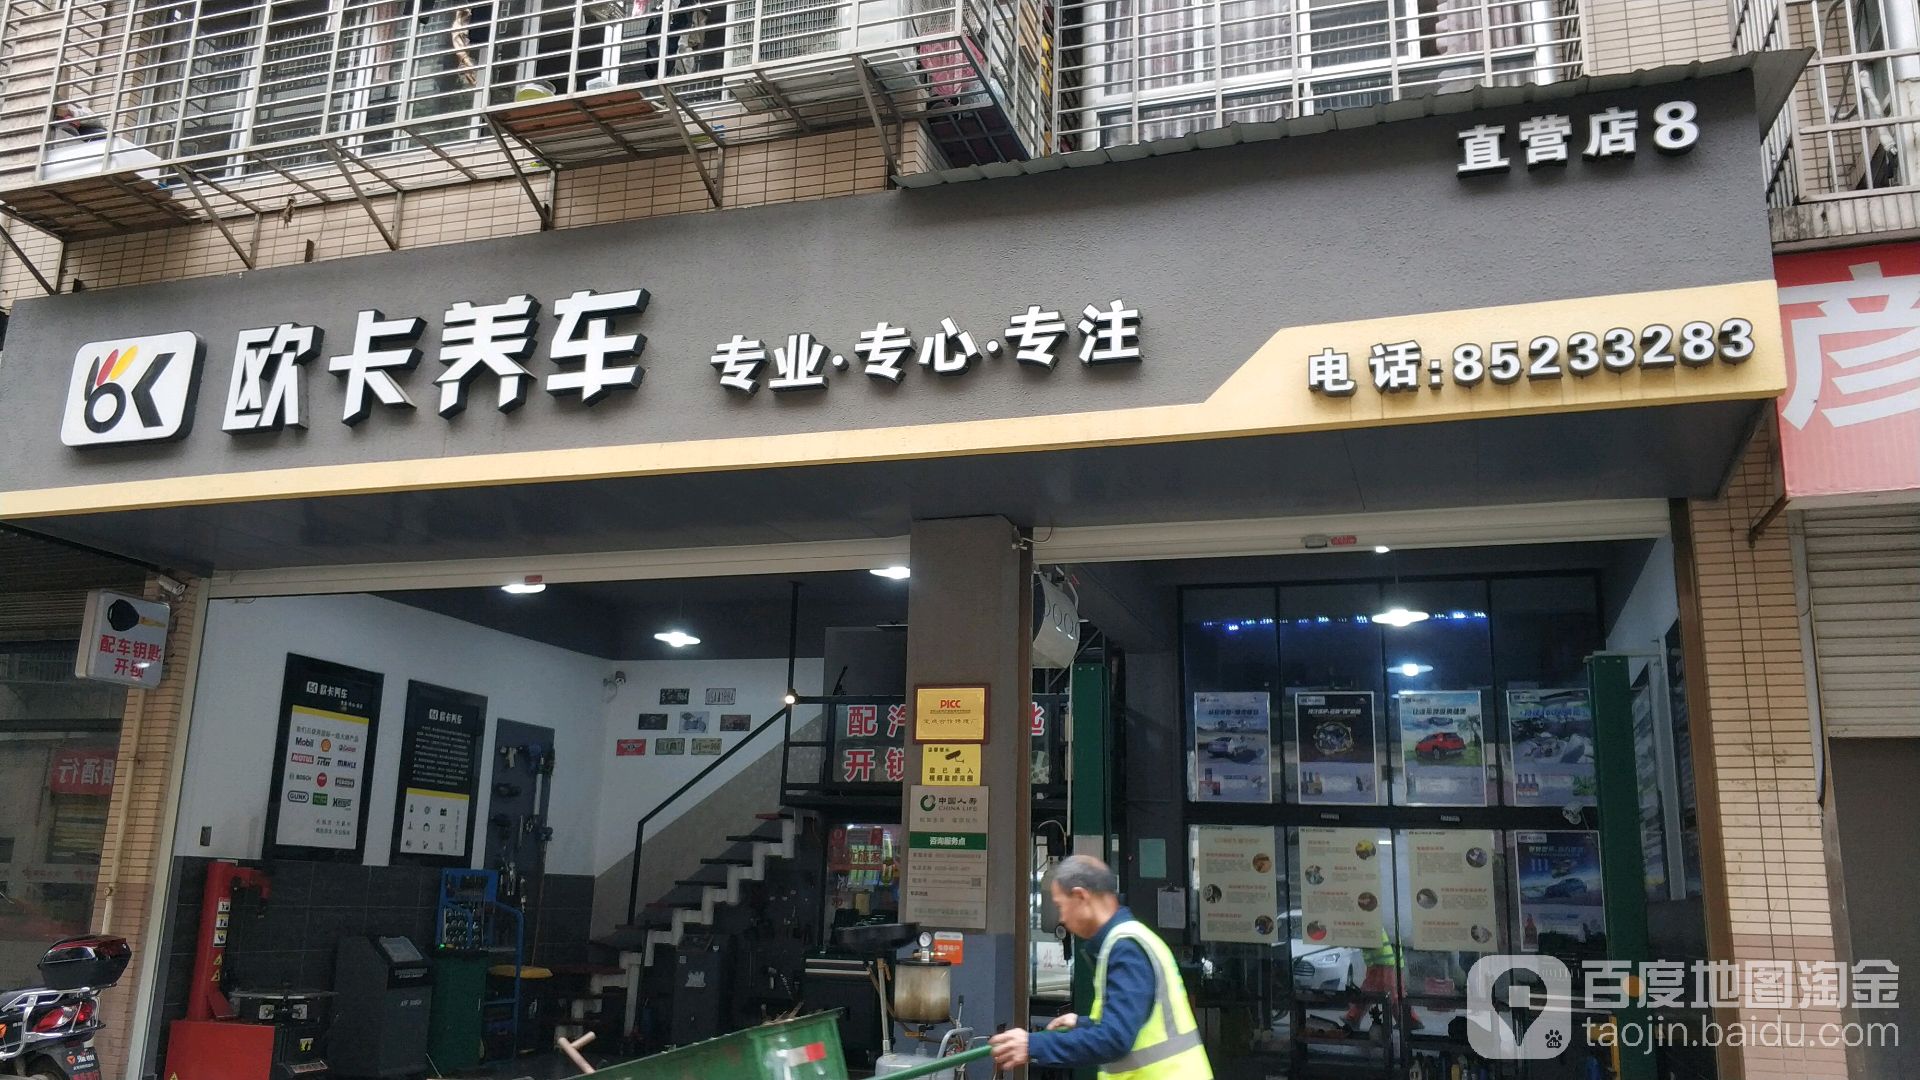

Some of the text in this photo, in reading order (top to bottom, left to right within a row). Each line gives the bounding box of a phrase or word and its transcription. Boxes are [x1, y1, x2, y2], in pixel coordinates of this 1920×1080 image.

[1457, 101, 1698, 176] 直营店8
[222, 288, 651, 434] 欧卡养车
[1308, 318, 1755, 396] 电话:85233283
[99, 634, 162, 662] 配车钥匙
[114, 658, 145, 679] 开锁
[940, 700, 961, 709] PICC
[938, 797, 977, 805] 中国人寿
[929, 836, 966, 846] 咨询服务点
